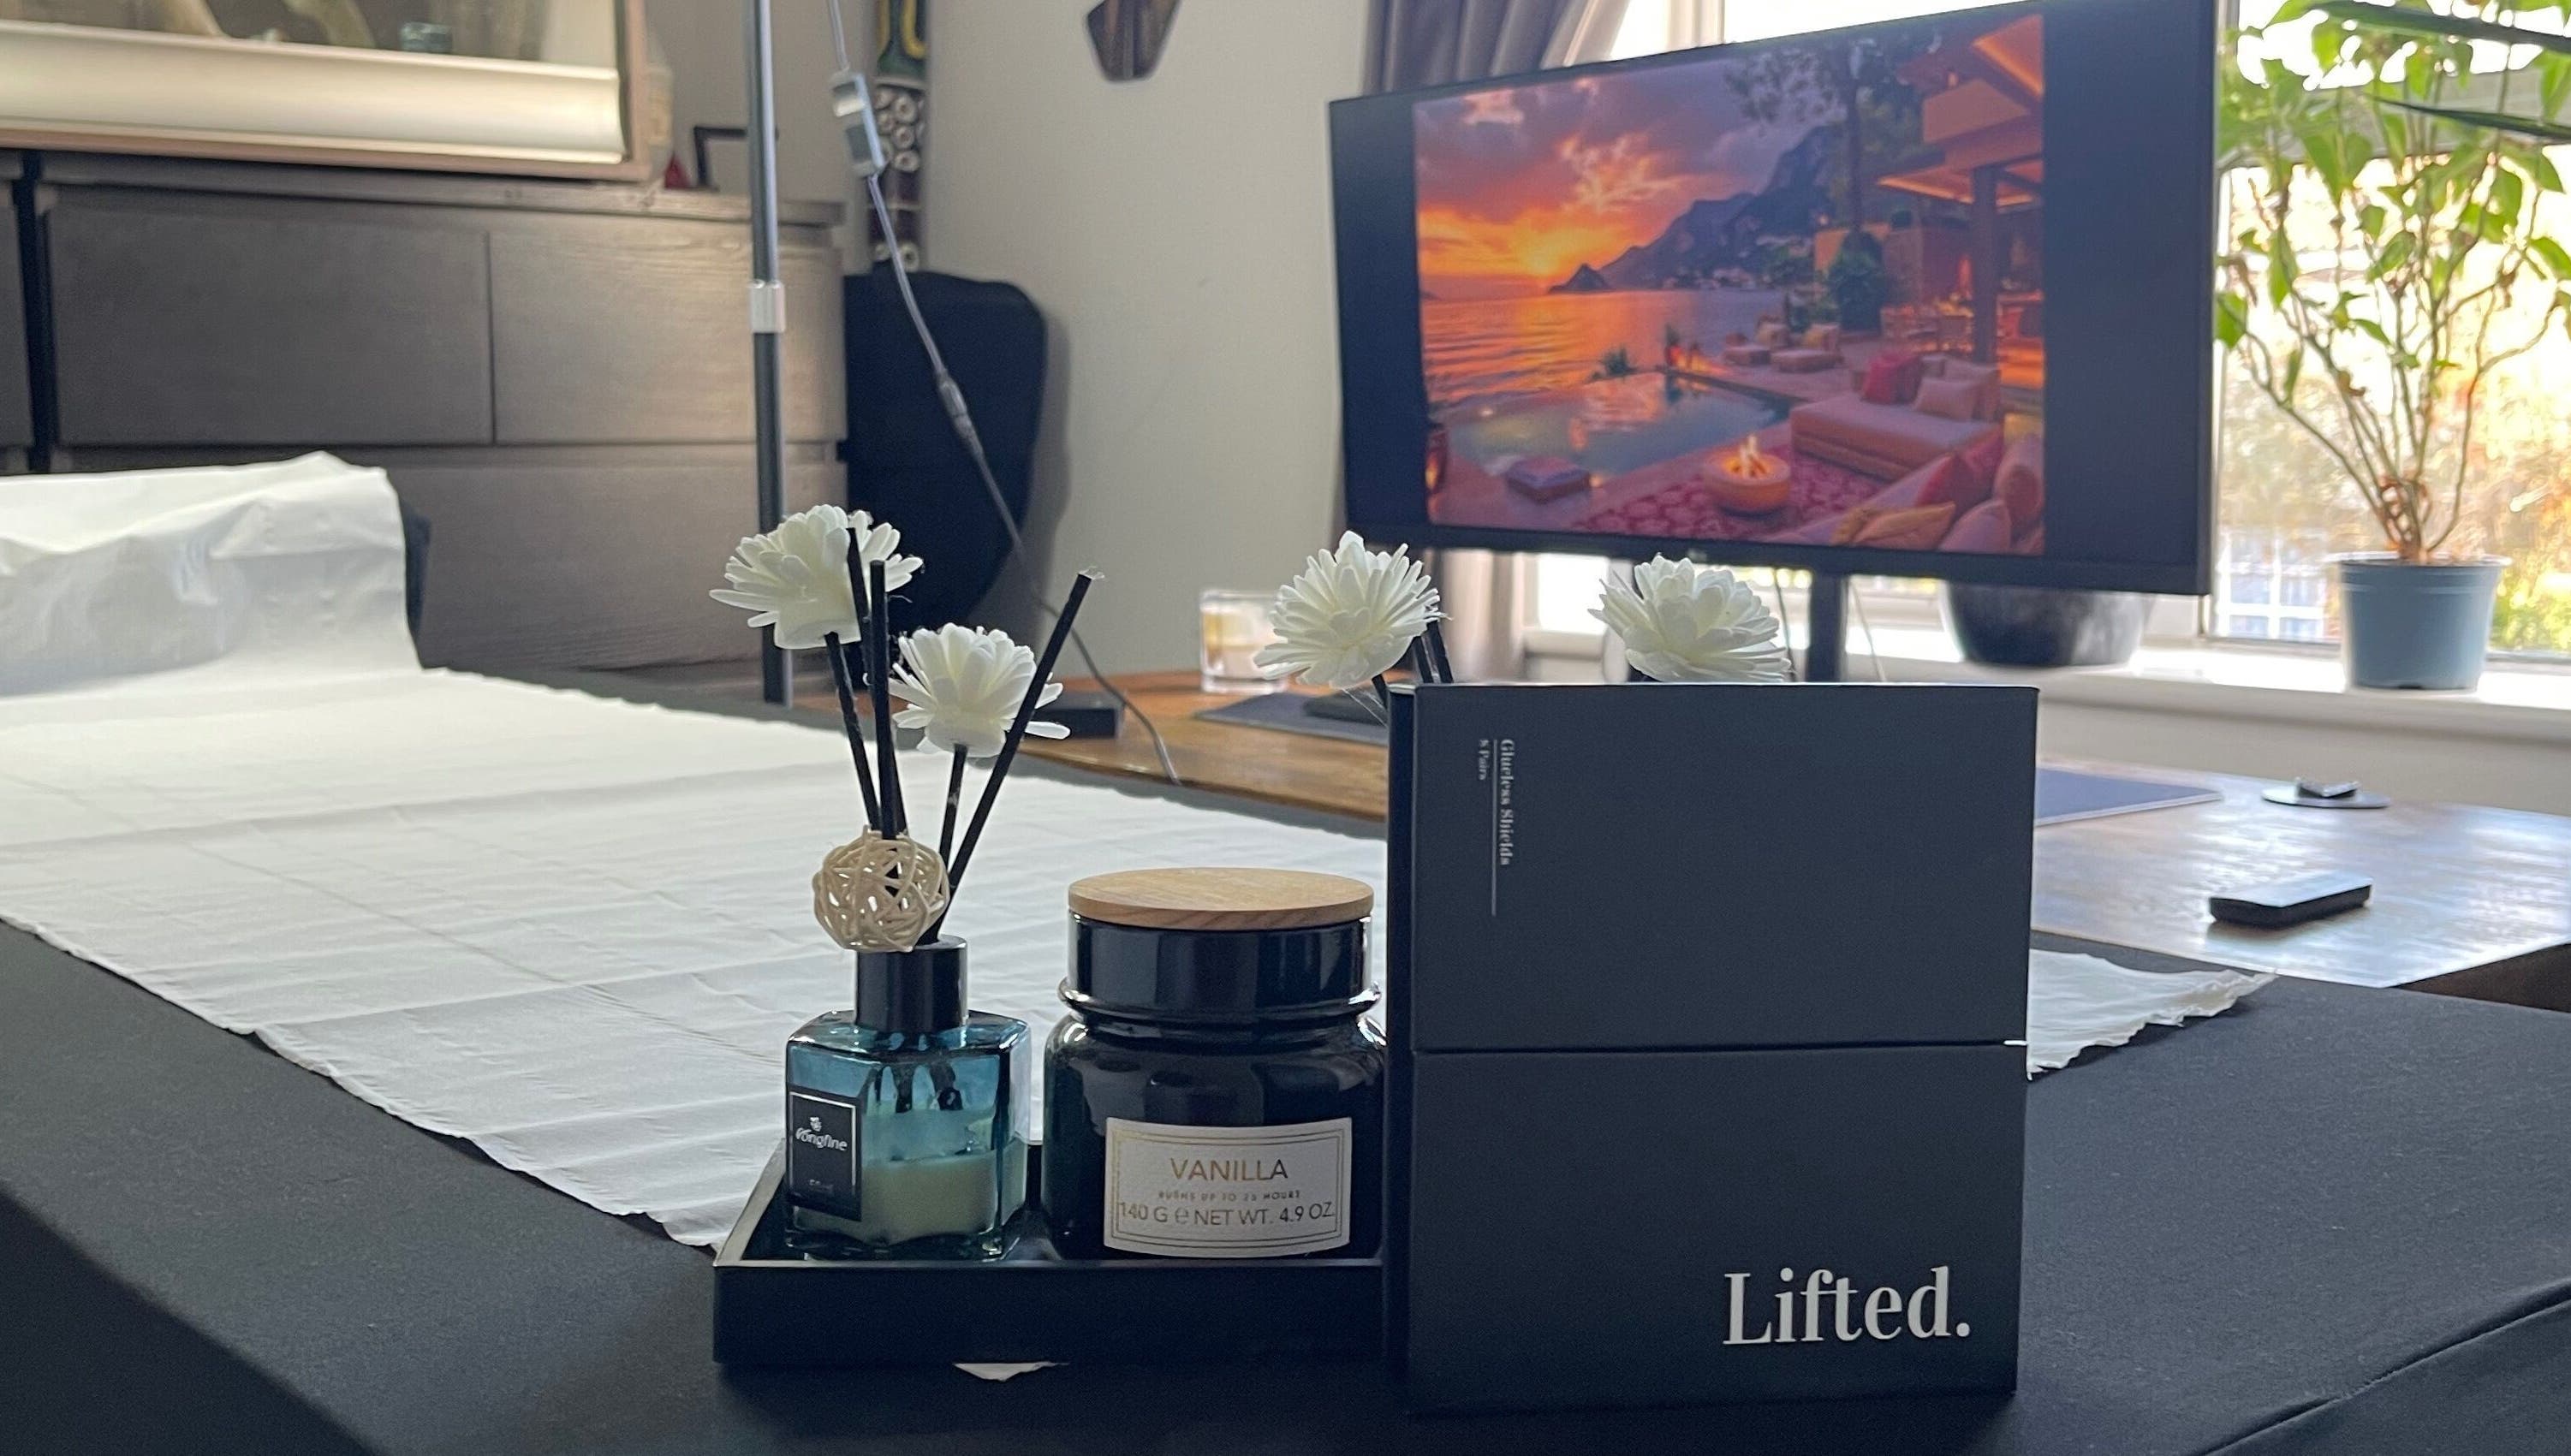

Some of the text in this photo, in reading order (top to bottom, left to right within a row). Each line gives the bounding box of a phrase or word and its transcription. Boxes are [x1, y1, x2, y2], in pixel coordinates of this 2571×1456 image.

[1479, 750, 1490, 780] Pairs
[1499, 739, 1515, 865] Glueless Shields
[1169, 1157, 1288, 1181] VANILLA
[1119, 1202, 1149, 1221] 140
[1153, 1205, 1168, 1223] G
[1193, 1209, 1234, 1226] NET
[1241, 1208, 1275, 1225] WT.
[1280, 1205, 1304, 1222] 4.9
[1309, 1202, 1336, 1220] OZ
[1723, 1265, 1970, 1345] Lifted.
